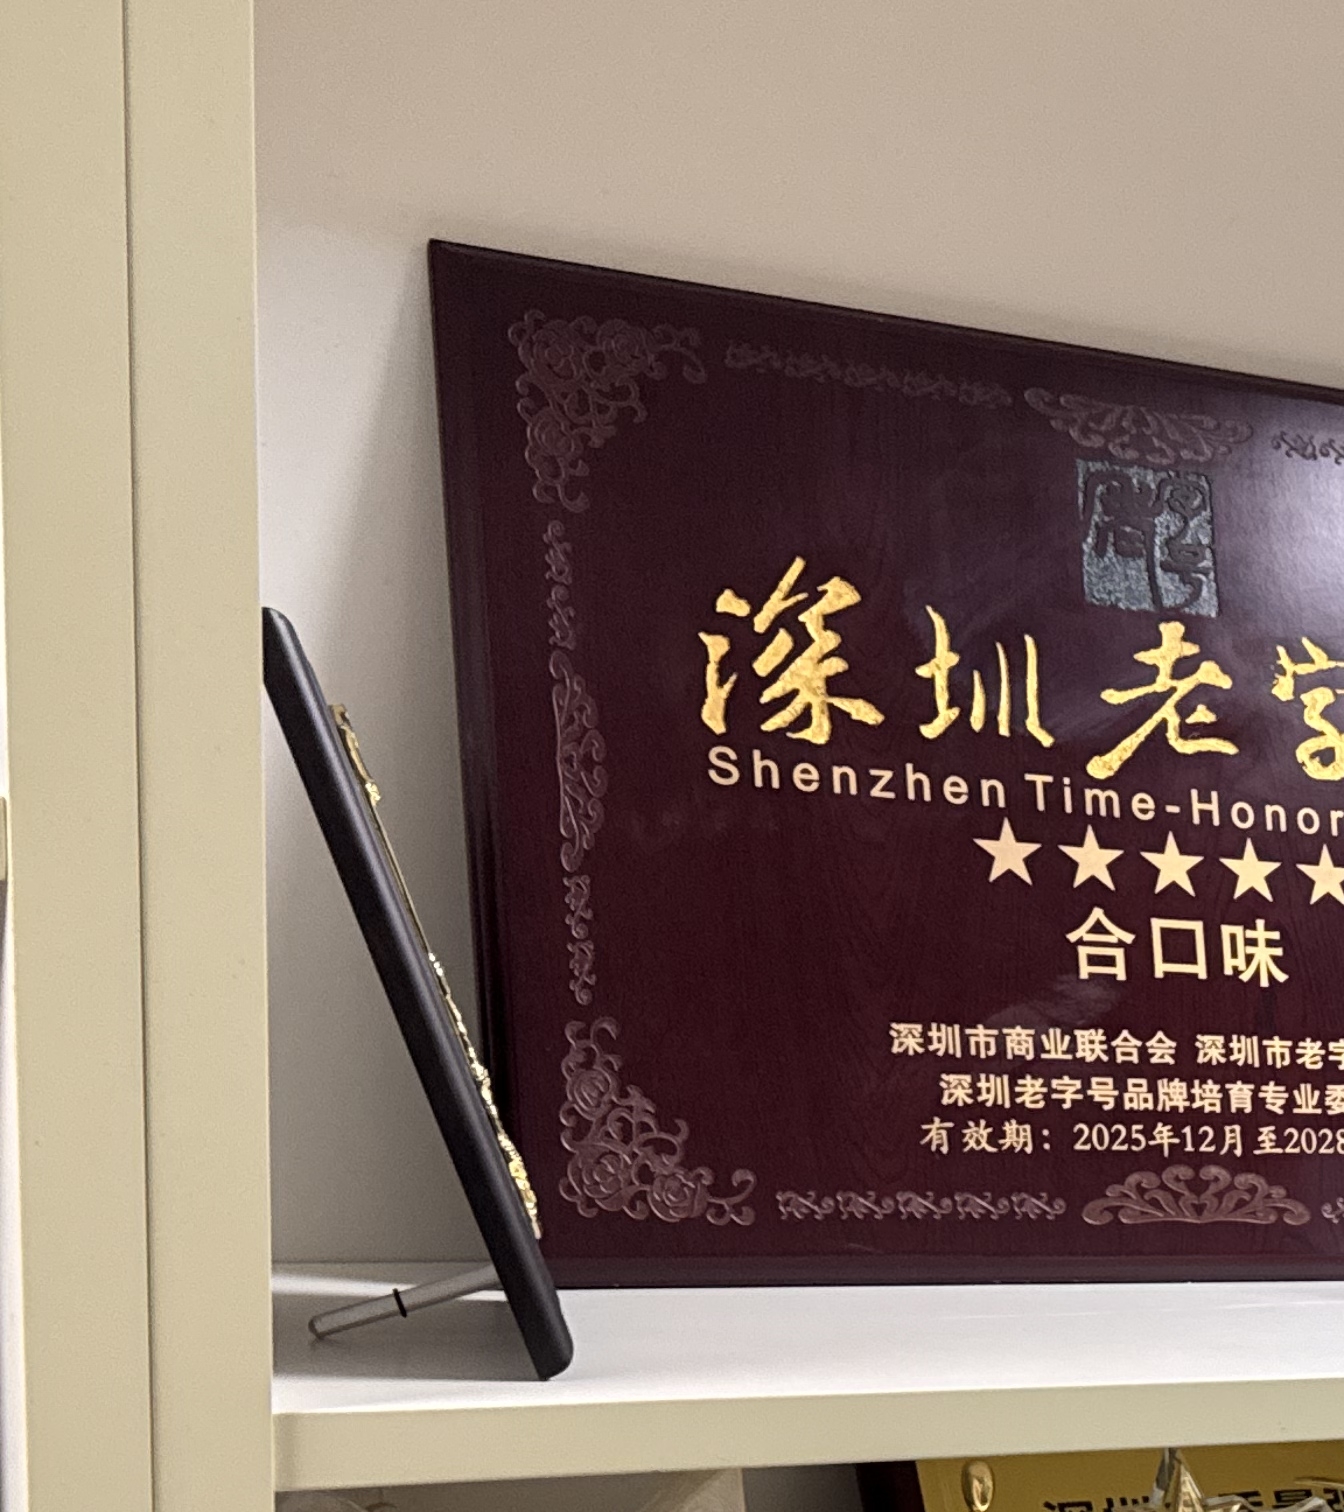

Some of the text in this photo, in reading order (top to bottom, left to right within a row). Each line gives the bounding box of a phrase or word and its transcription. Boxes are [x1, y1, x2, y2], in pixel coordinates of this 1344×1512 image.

[706, 746, 1008, 808] Shenzhen
[1067, 906, 1289, 988] 合口味
[888, 1022, 1178, 1065] 深圳市商业联合会
